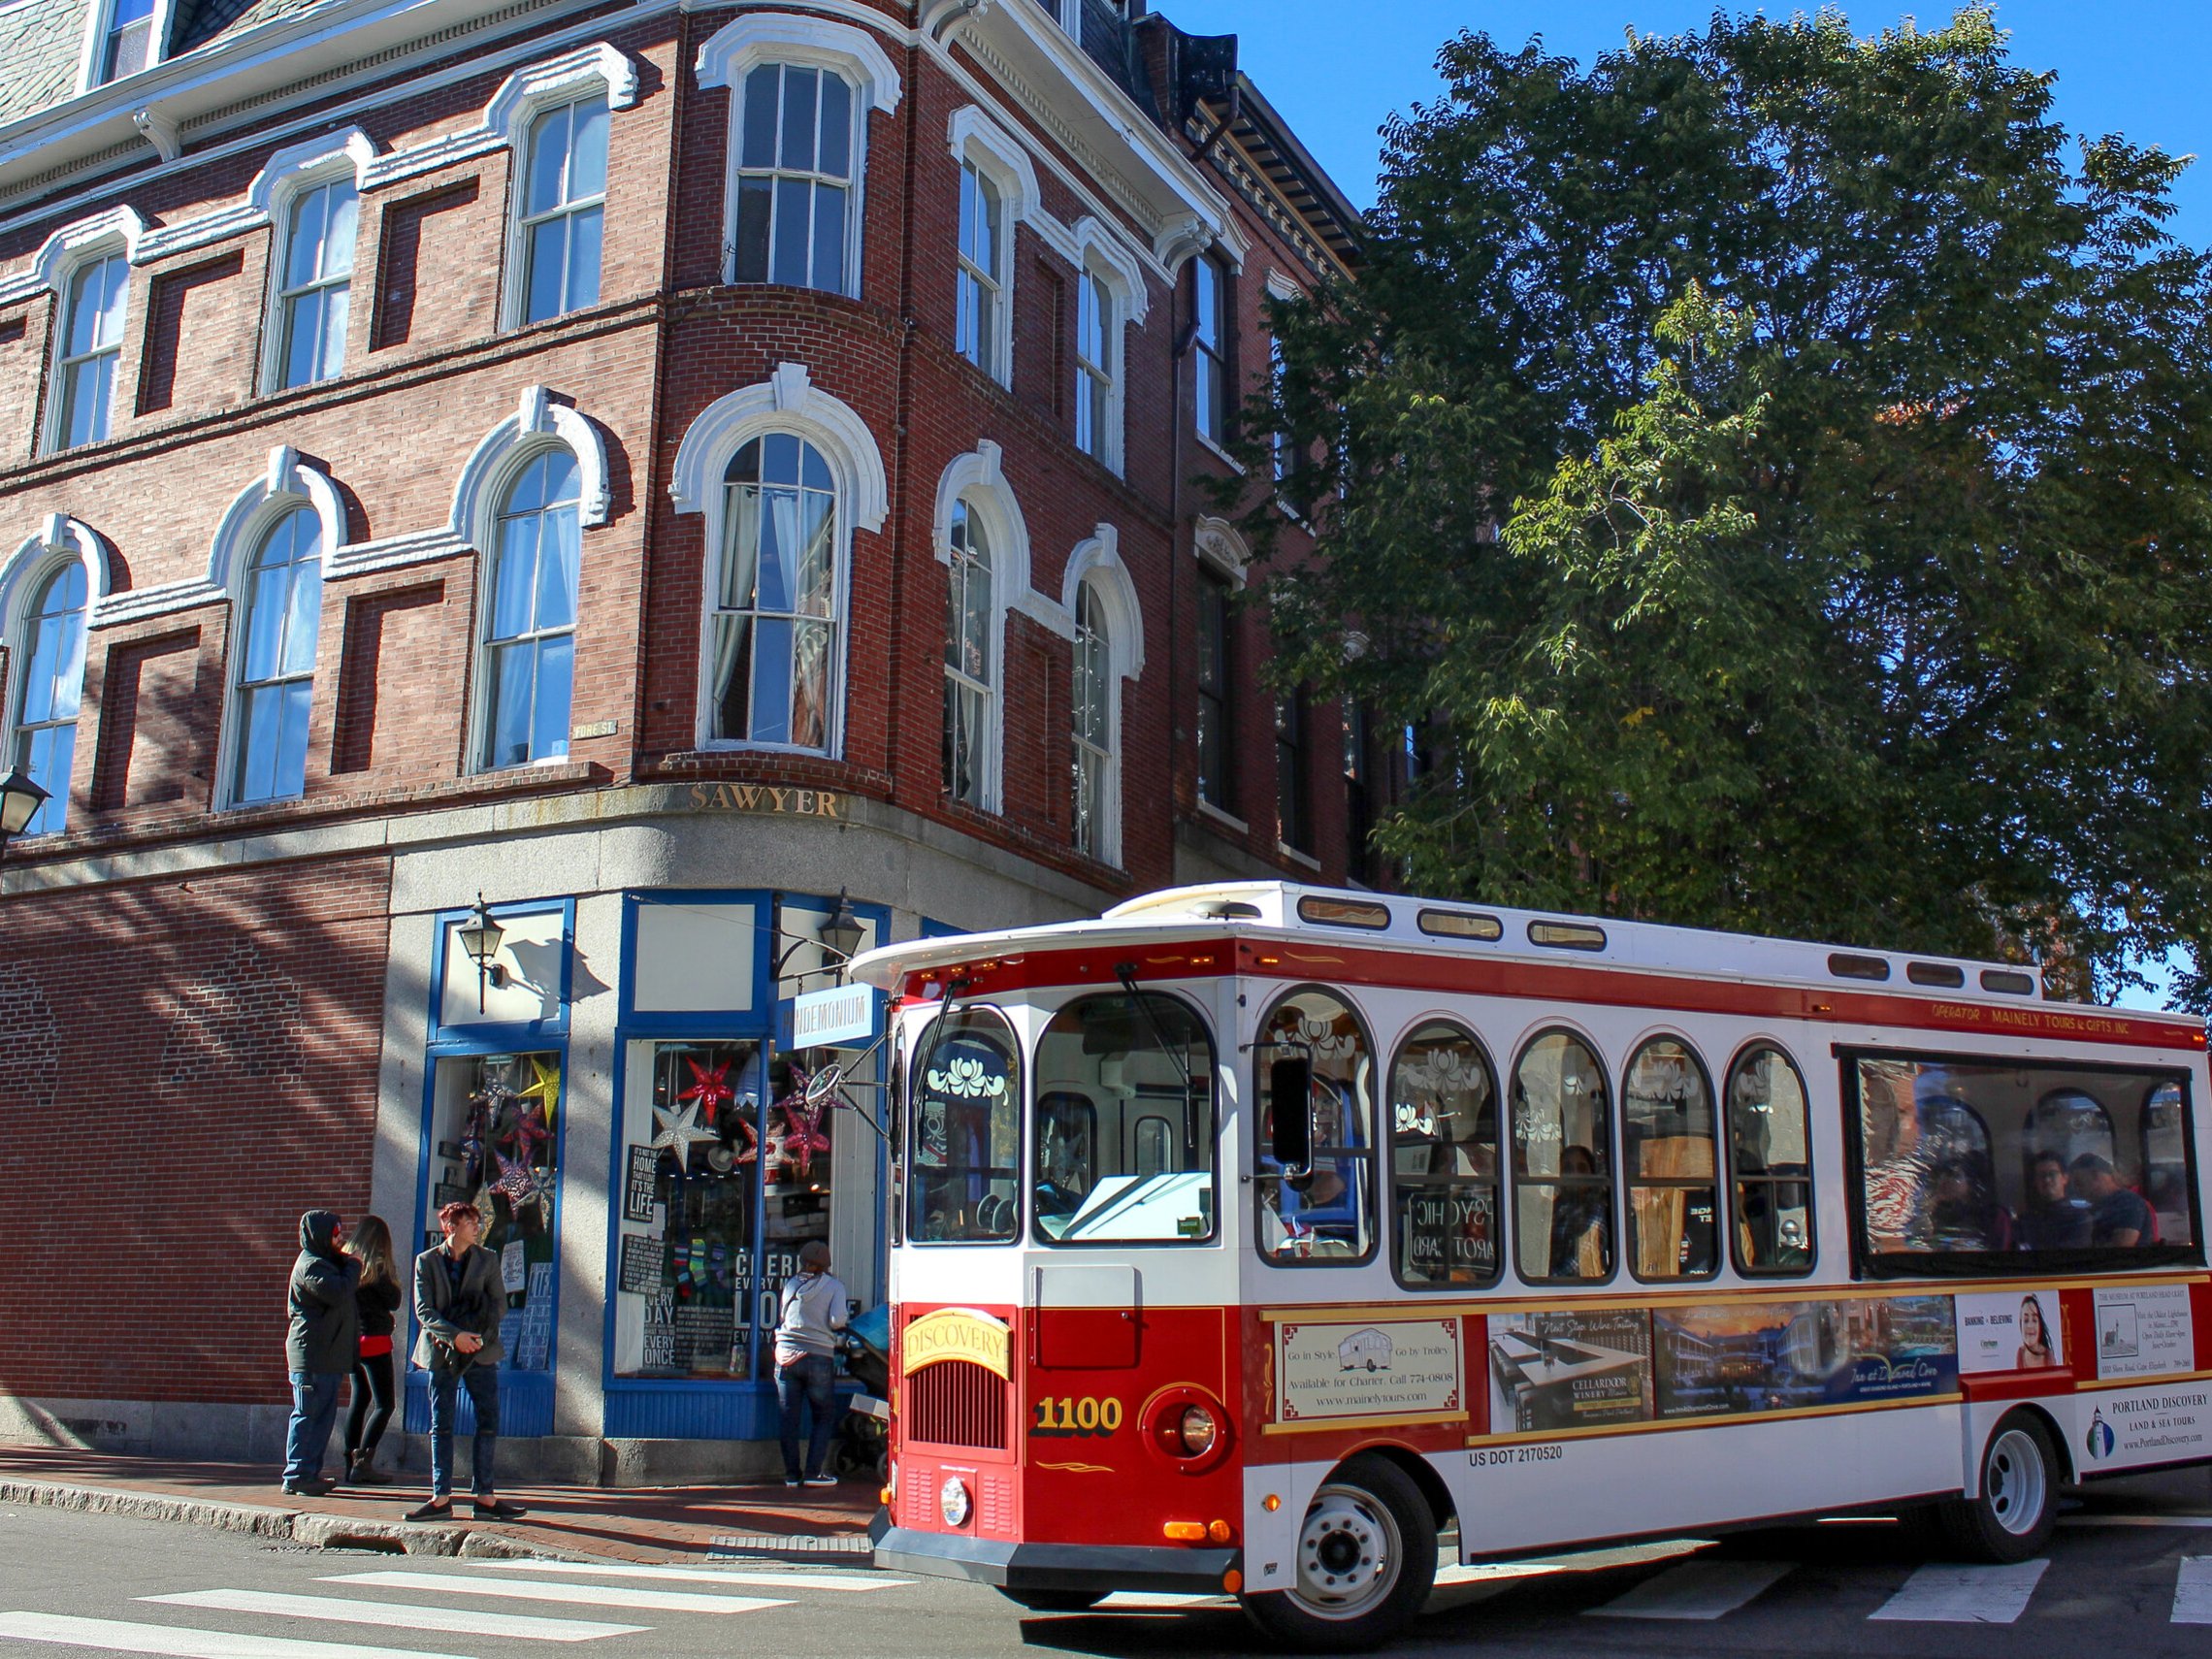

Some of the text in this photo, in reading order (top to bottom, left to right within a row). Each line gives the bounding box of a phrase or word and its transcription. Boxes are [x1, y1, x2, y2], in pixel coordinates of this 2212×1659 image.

[575, 723, 599, 738] FORE
[690, 784, 837, 818] SAWYER
[1933, 1003, 1980, 1021] OPERATOR
[1992, 1009, 2039, 1027] MAINELY
[2044, 1015, 2075, 1029] TOURS
[2086, 1019, 2111, 1033] GIFTS
[633, 1155, 657, 1174] HOME
[631, 1179, 655, 1194] IT'S THE
[630, 1190, 654, 1215] LIFE
[644, 1293, 674, 1307] VERY
[644, 1335, 675, 1350] EVERY
[907, 1323, 1004, 1359] DISCOVERY
[644, 1349, 676, 1365] ONCE
[1287, 1350, 1300, 1361] Go
[1303, 1350, 1312, 1360] in
[1395, 1348, 1407, 1356] Go
[1409, 1347, 1419, 1356] by
[1287, 1378, 1330, 1390] Available
[1333, 1377, 1347, 1387] for
[1389, 1374, 1407, 1385] Call
[1410, 1372, 1453, 1384] 774-0808
[1573, 1377, 1627, 1390] CELLARDOOR
[1316, 1392, 1427, 1406] www.mainelytours.com
[1573, 1389, 1606, 1399] WINERY
[2112, 1393, 2208, 1414] PORTLAND DISCOVERY
[1034, 1396, 1123, 1433] 1100
[2129, 1415, 2196, 1432] LAND & SEA TOURS
[2123, 1434, 2203, 1450] www.PortlandDiscovery.com
[1469, 1445, 1563, 1467] US DOT 2170520
